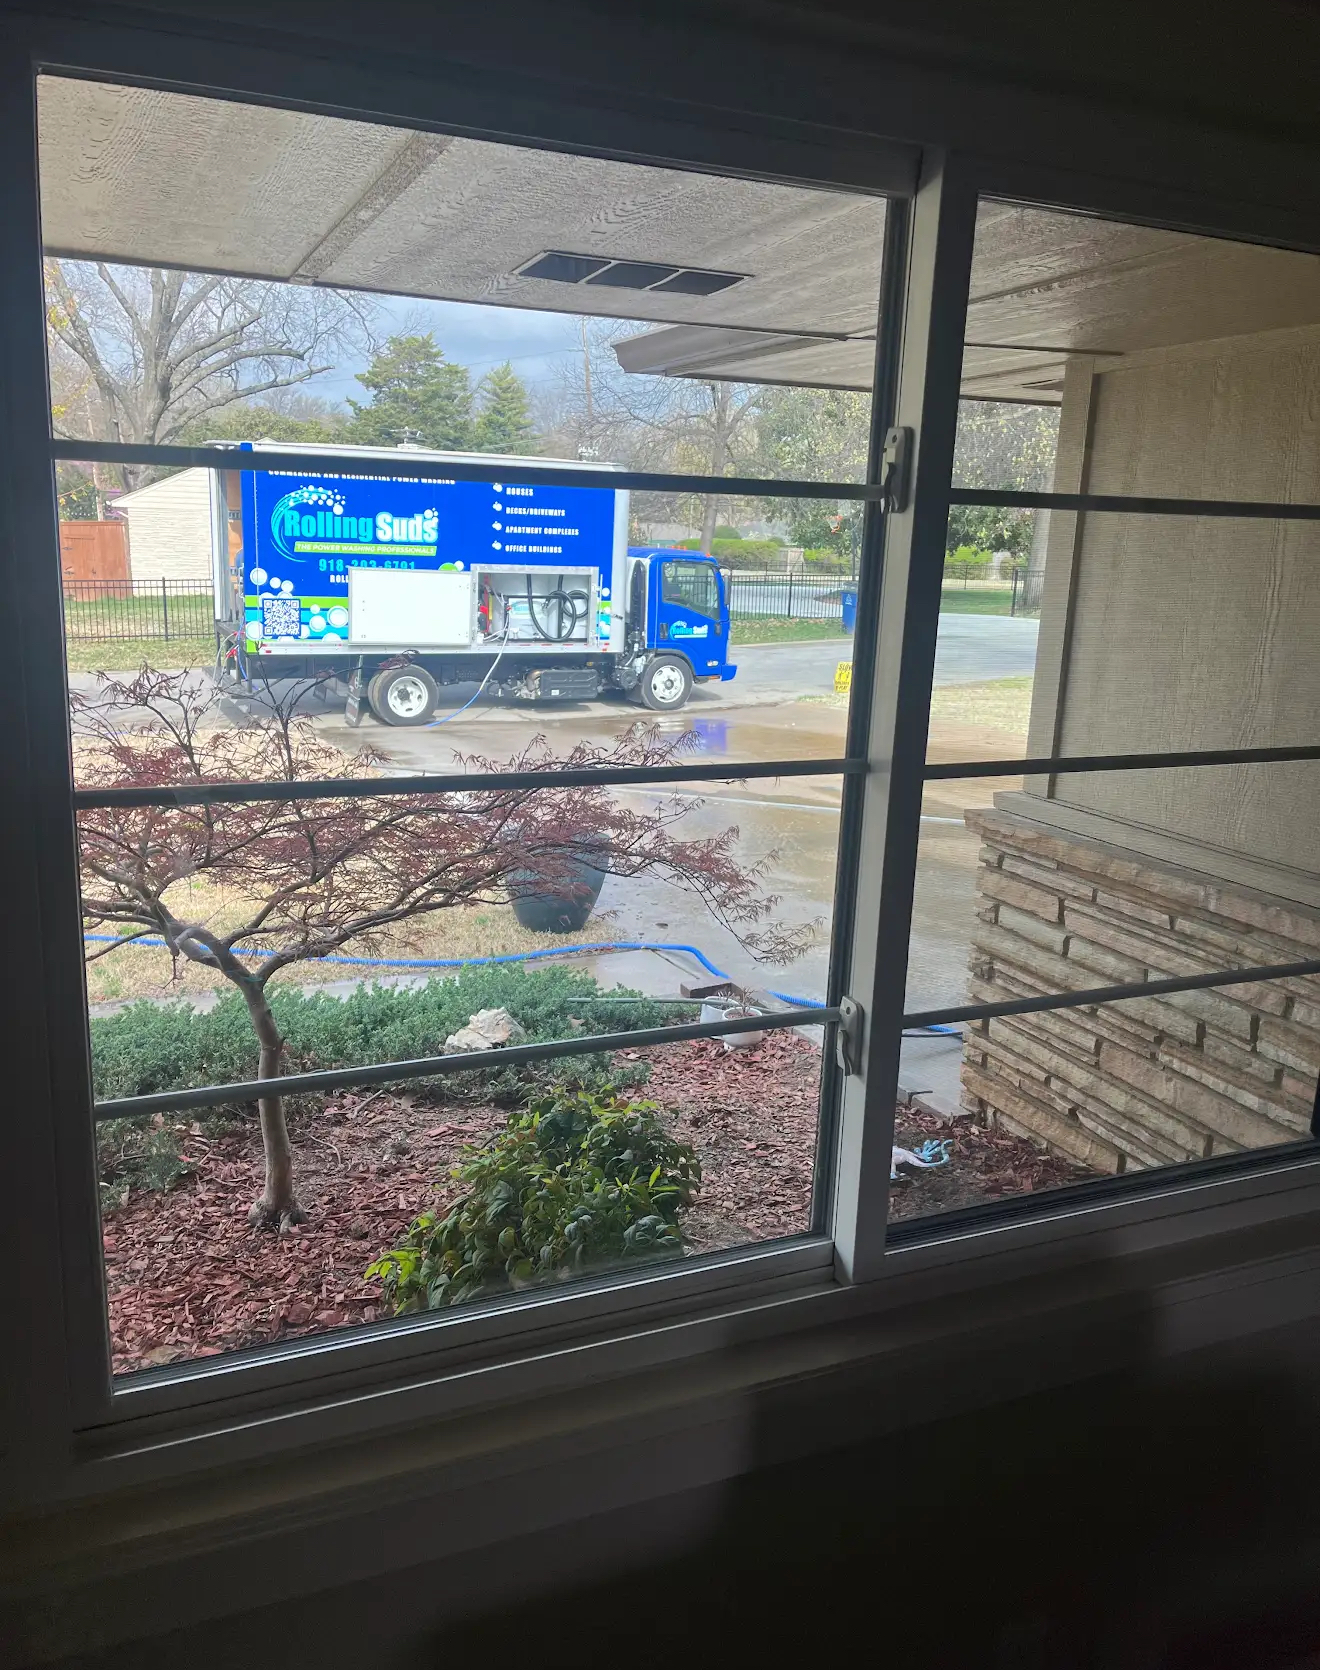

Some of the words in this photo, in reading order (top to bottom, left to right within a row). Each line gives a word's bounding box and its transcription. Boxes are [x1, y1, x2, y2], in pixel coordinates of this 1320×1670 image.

[505, 487, 534, 497] HOUSES
[505, 506, 566, 517] DECKS/DRIVEWAYS
[284, 509, 373, 543] Rolling
[375, 510, 439, 543] Suds
[505, 525, 542, 535] APARTMENT
[543, 527, 580, 536] COMPLEXES
[377, 545, 434, 554] PROFESSIONALS
[504, 544, 527, 553] OFFICE
[528, 545, 563, 554] BUILDINGS
